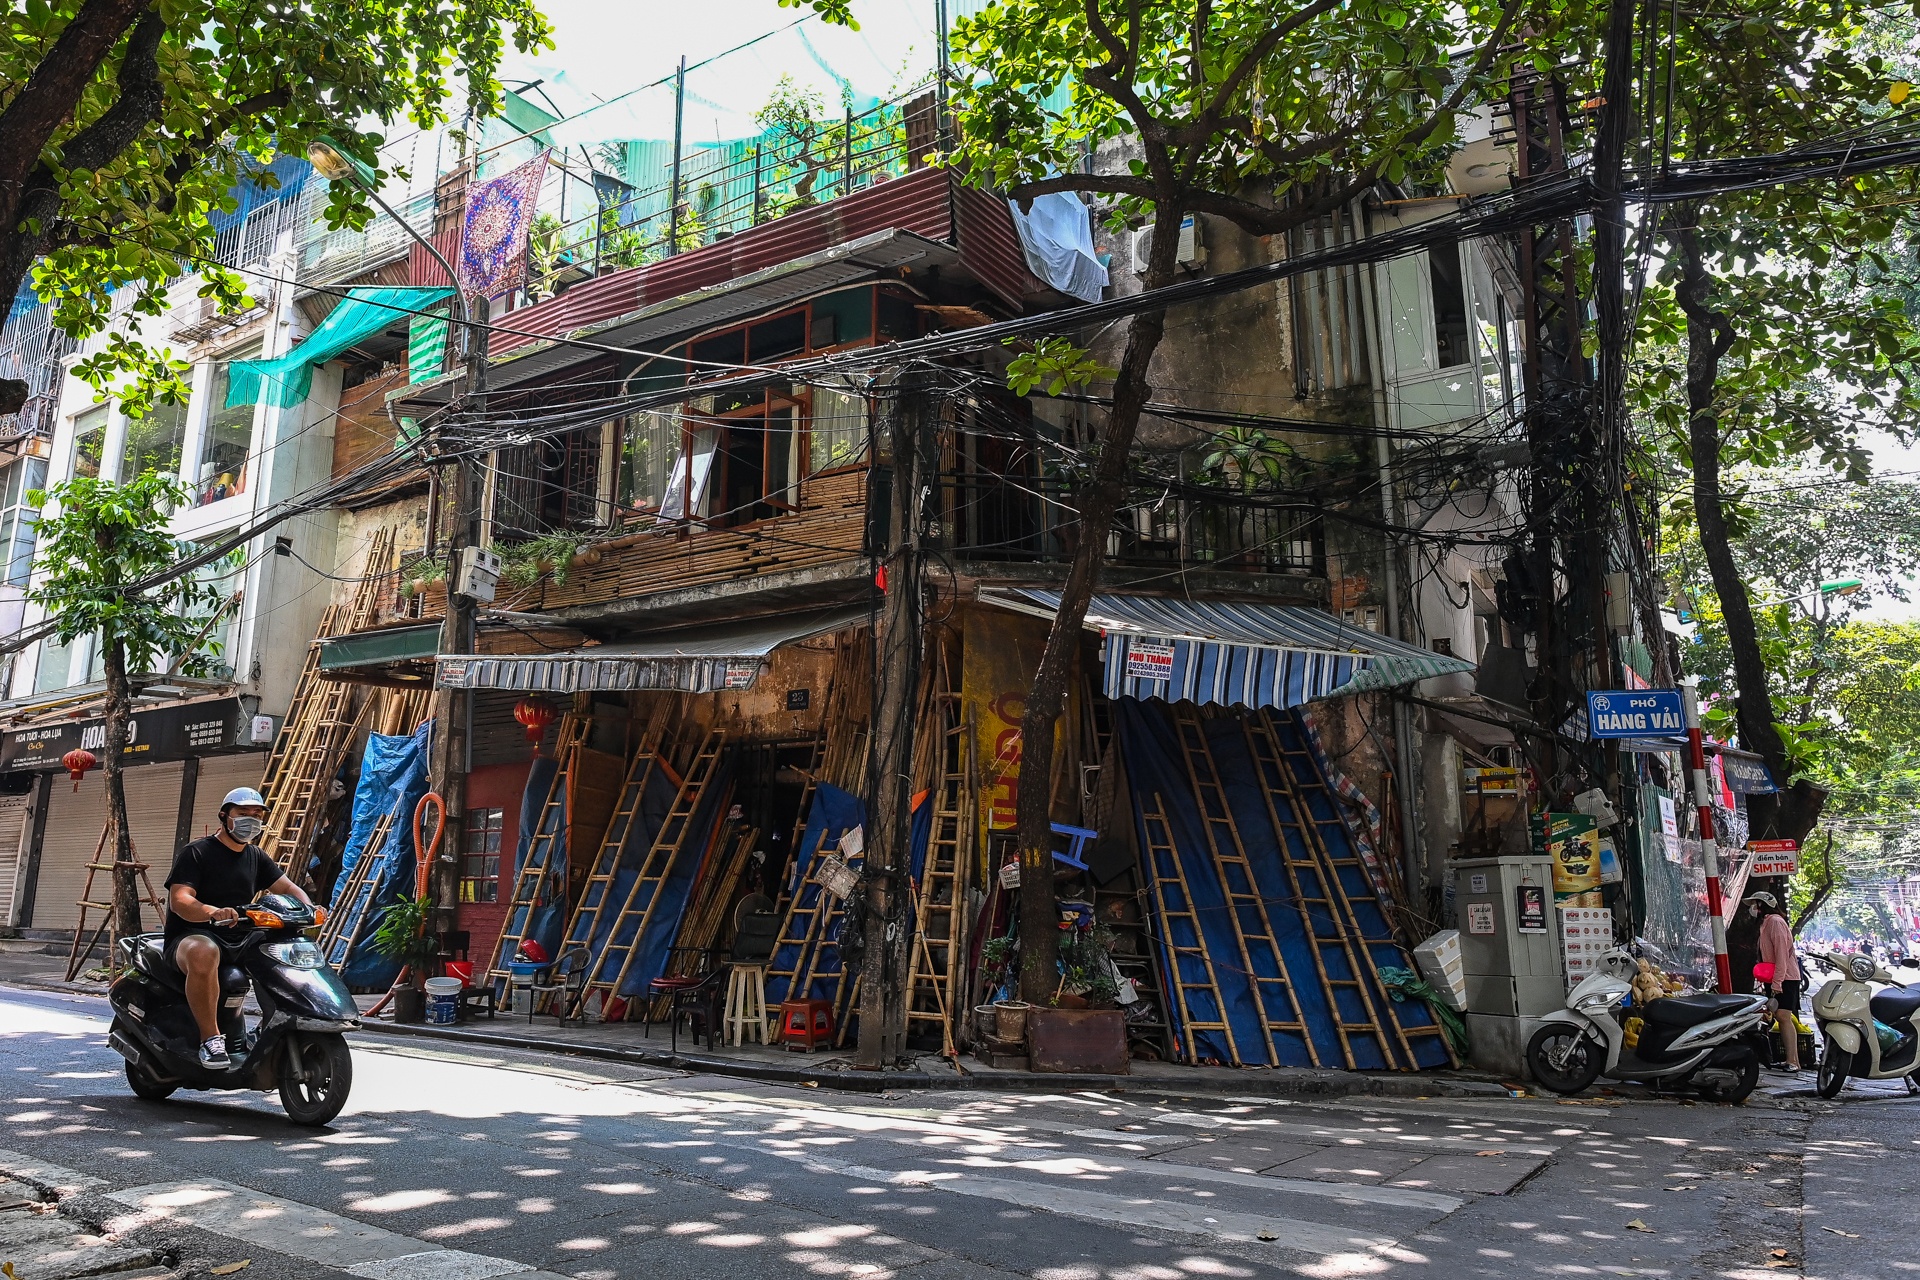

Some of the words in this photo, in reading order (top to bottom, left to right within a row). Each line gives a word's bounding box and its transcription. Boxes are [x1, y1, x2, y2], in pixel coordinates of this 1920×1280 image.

[1630, 696, 1656, 707] PHỐ
[1598, 710, 1646, 729] HÀNG
[1650, 707, 1680, 728] VẢI
[15, 734, 26, 743] HOA
[40, 730, 51, 739] HOA
[1754, 864, 1772, 873] SIM
